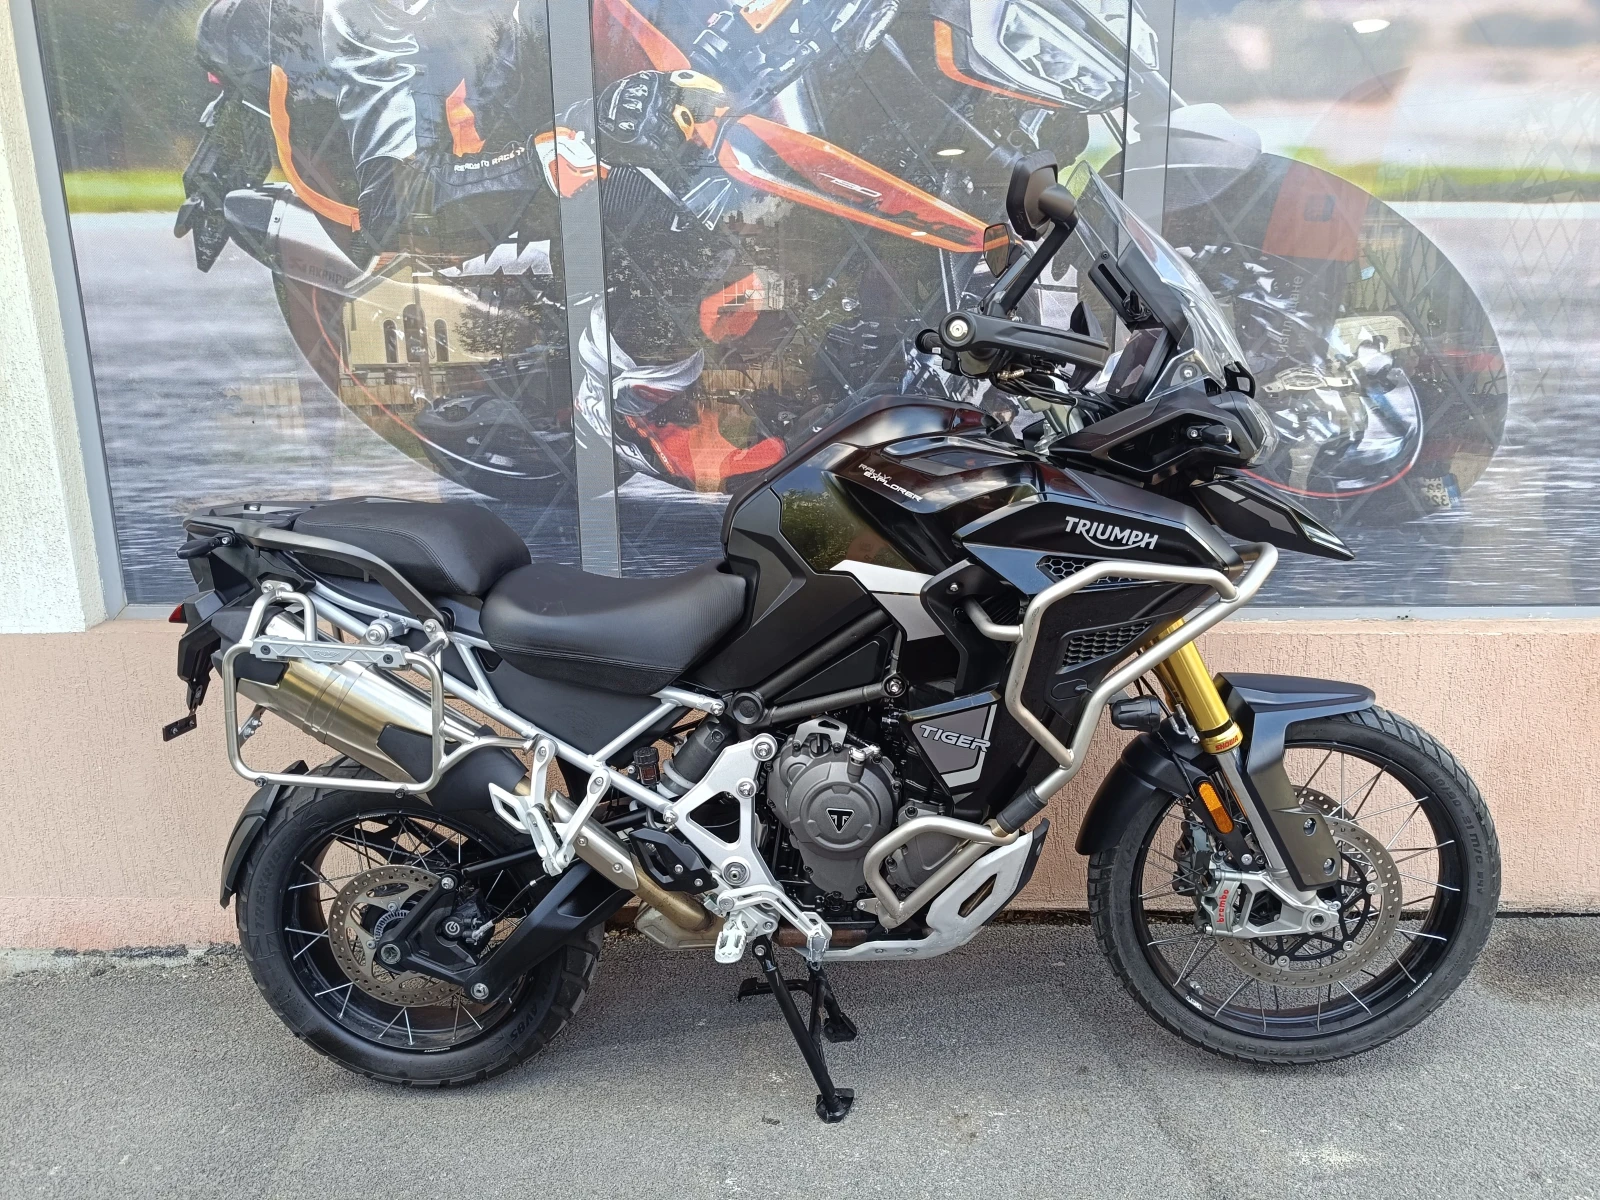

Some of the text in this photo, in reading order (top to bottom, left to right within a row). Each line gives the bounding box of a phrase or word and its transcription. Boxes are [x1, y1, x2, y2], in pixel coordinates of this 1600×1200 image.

[863, 471, 924, 503] EXPLORER
[1065, 516, 1159, 550] TRIUMPH
[920, 724, 991, 752] TIGER
[1215, 735, 1239, 751] SHOWA
[1216, 889, 1229, 923] brembo
[1236, 1041, 1332, 1057] METZELER
